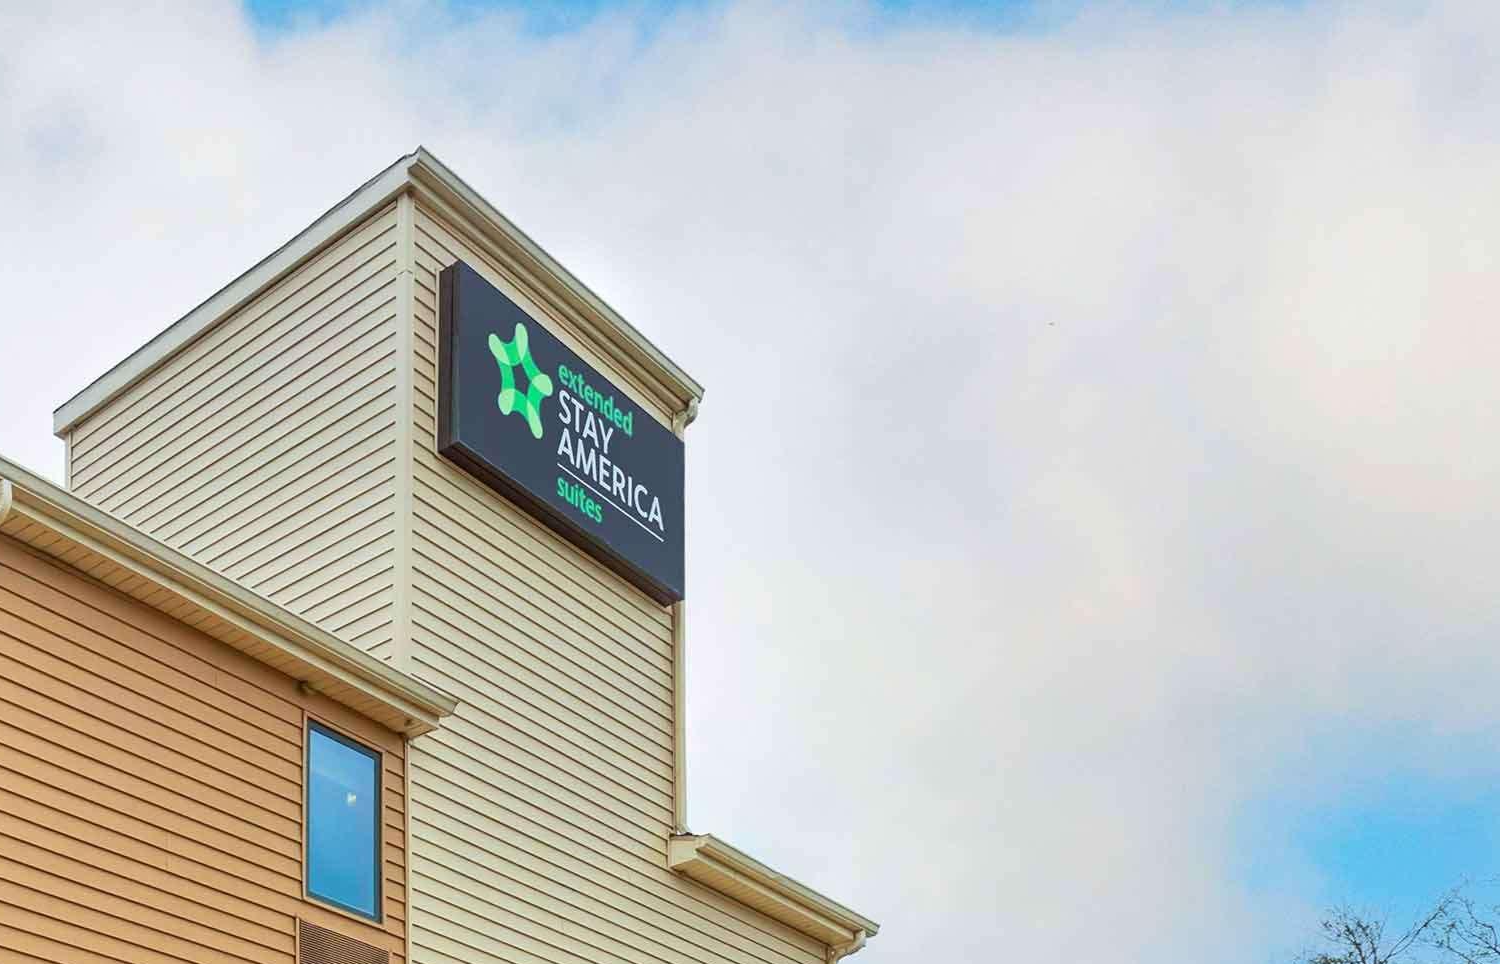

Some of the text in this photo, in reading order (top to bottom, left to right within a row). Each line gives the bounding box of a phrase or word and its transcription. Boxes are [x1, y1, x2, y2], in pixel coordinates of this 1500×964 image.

[558, 364, 633, 437] extended
[558, 390, 614, 454] STAY
[557, 428, 664, 531] AMERICA
[557, 477, 603, 523] suites
